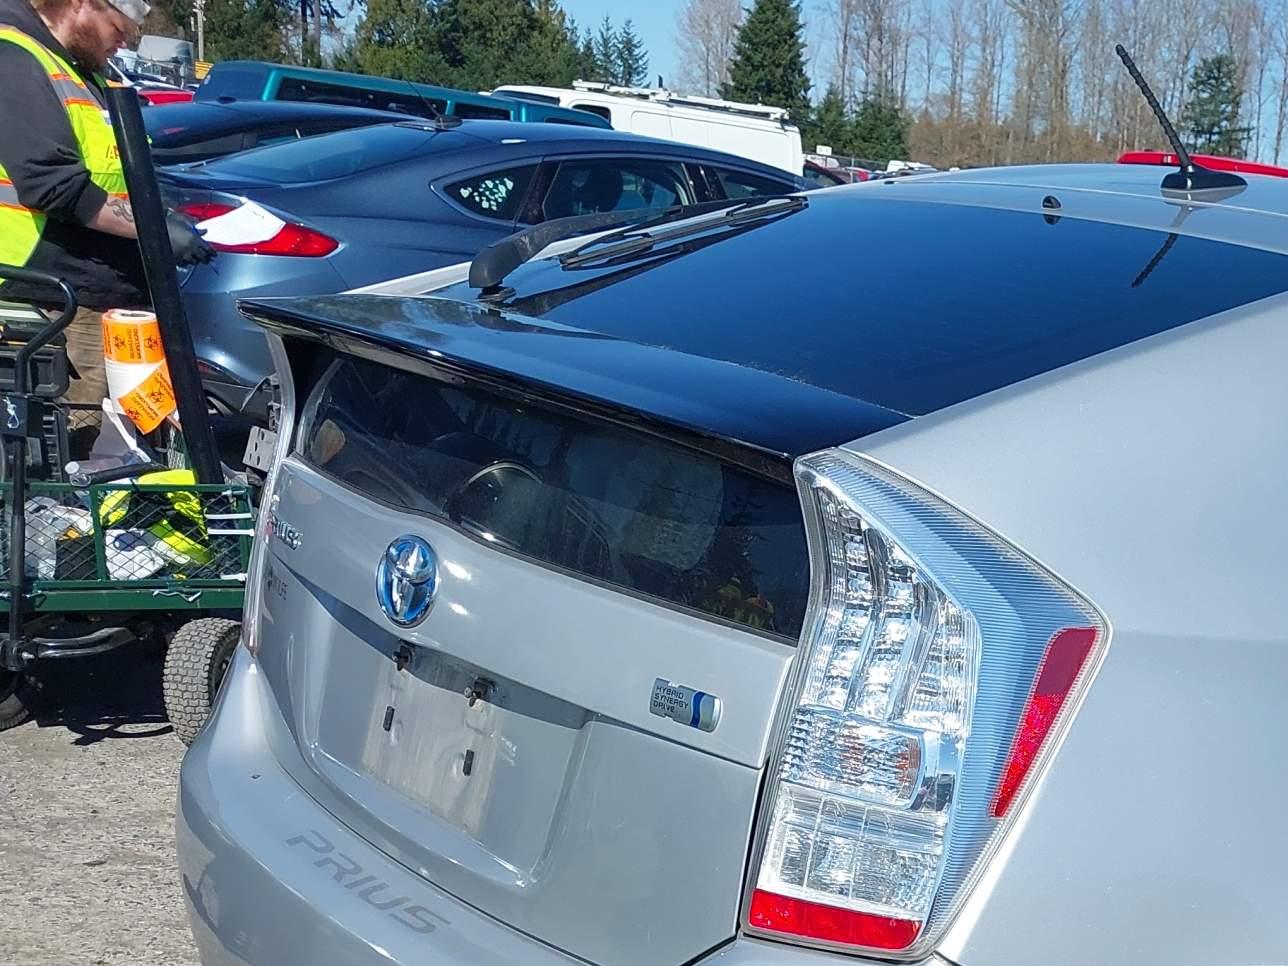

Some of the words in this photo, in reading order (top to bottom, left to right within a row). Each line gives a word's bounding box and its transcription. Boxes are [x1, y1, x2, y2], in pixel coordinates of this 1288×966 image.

[654, 692, 689, 709] SYNERGY
[656, 685, 684, 700] HYBRID
[653, 700, 675, 713] DRIVE
[285, 829, 452, 935] PRIUS
